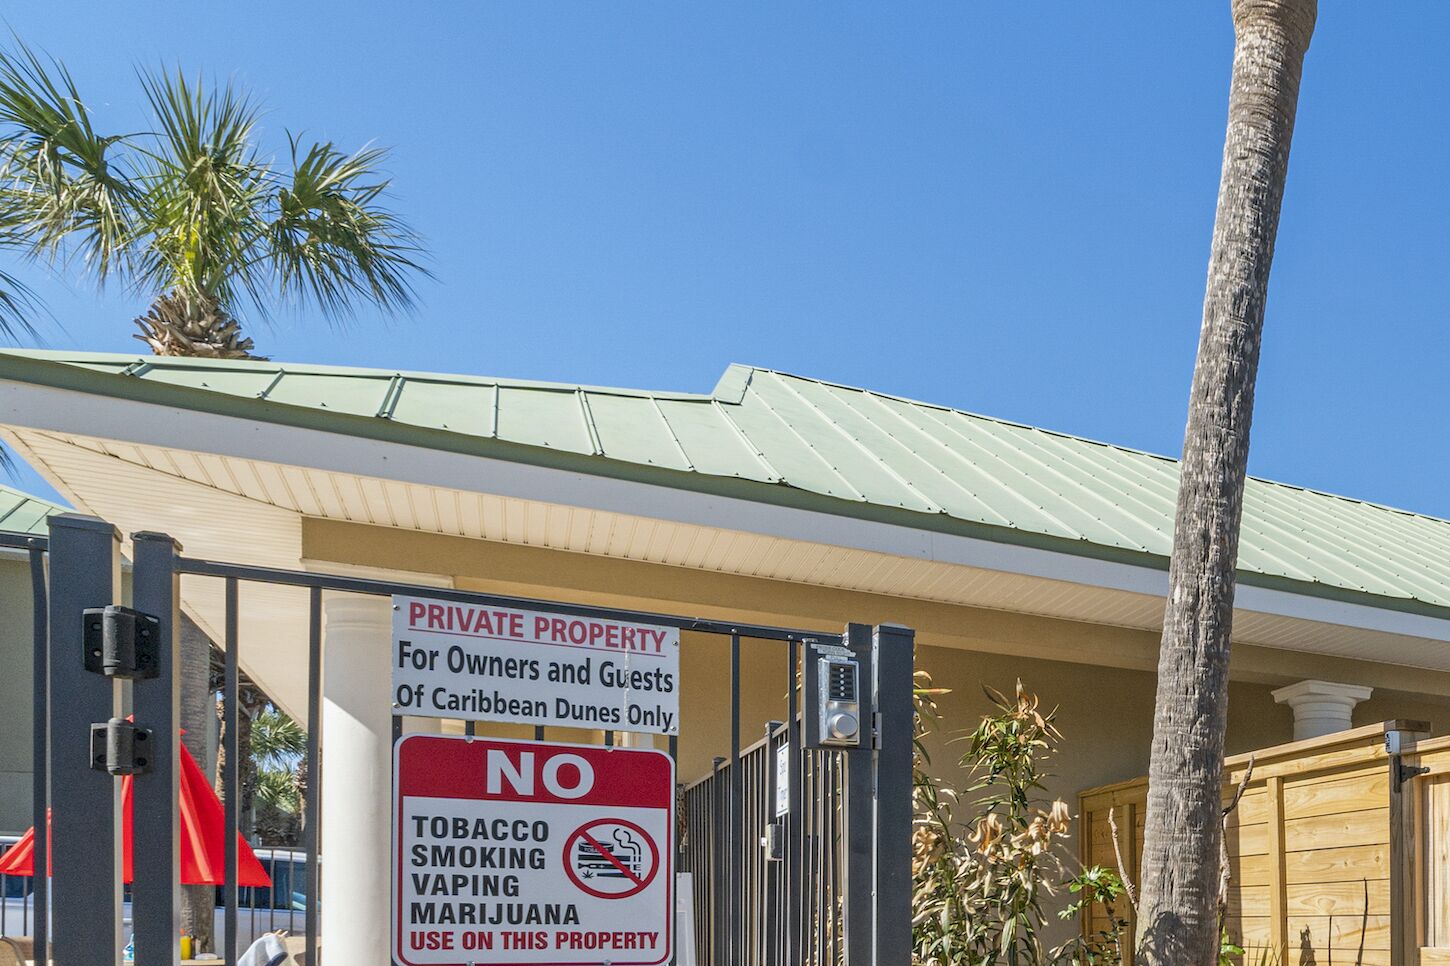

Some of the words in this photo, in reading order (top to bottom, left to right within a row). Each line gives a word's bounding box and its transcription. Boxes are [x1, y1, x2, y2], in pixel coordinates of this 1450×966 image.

[409, 601, 524, 638] PRIVATE
[534, 616, 667, 653] PROPERTY
[398, 640, 439, 671] For
[447, 645, 540, 681] Owners
[547, 657, 591, 685] and
[599, 660, 674, 693] Guests
[396, 683, 425, 708] Of
[432, 687, 547, 718] Caribbean
[555, 697, 621, 724] Dunes
[628, 703, 674, 733] Only
[486, 749, 596, 799] NO
[411, 815, 550, 843] TOBACCO
[411, 844, 546, 870] SMOKING
[411, 873, 520, 897] VAPING
[410, 902, 580, 926] MARIJUANA
[410, 931, 454, 951] USE
[462, 931, 494, 951] ON
[500, 931, 549, 951] THIS
[555, 931, 660, 950] PROPERTY
